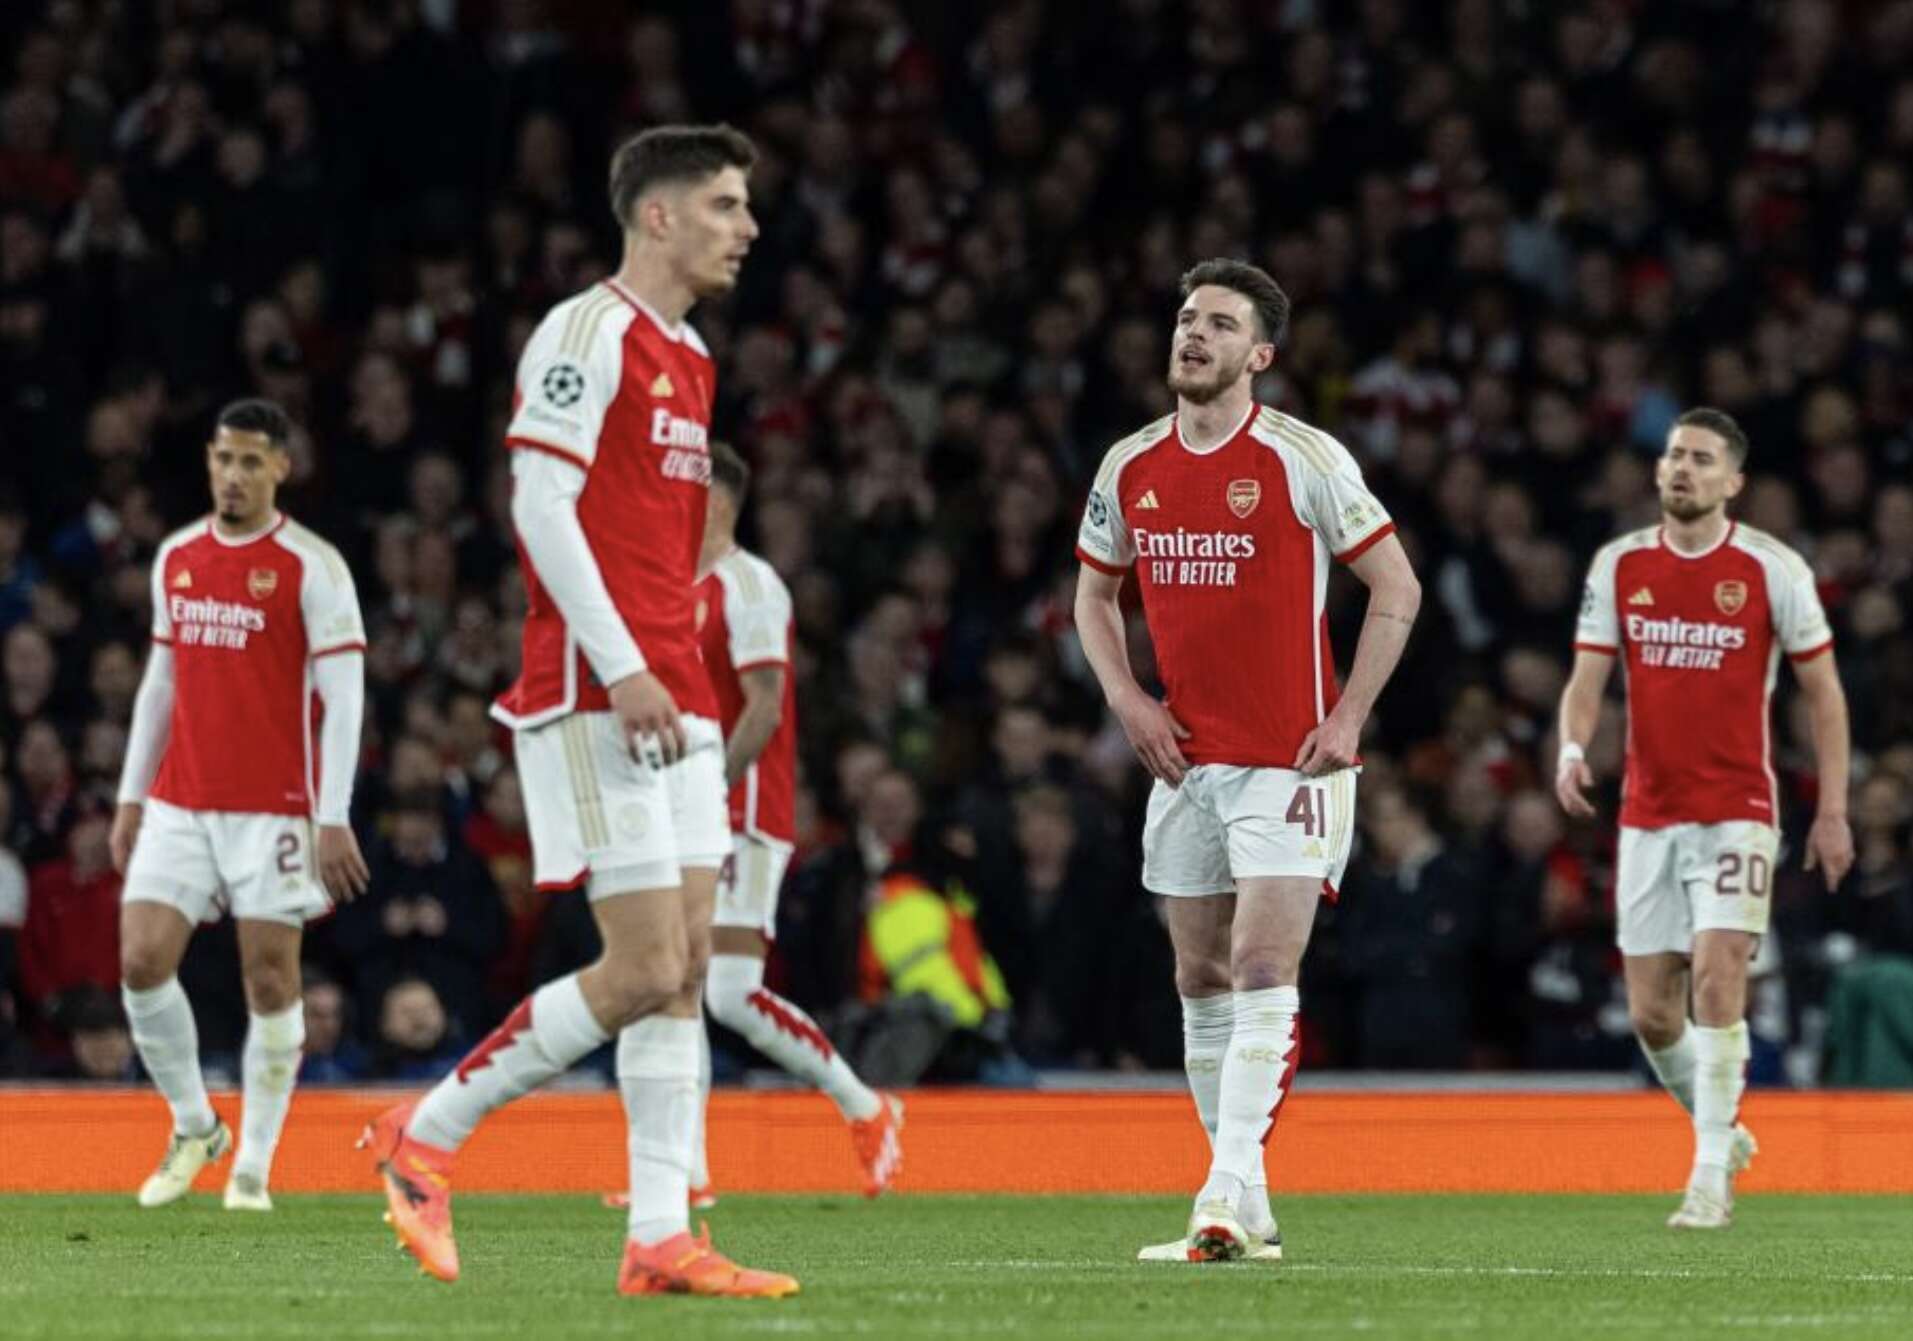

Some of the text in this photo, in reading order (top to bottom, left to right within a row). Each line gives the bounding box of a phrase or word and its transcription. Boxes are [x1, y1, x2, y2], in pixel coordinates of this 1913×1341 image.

[1133, 526, 1256, 558] Emirates
[1152, 561, 1237, 587] FLY BETTER
[171, 595, 265, 632] Emirates
[1626, 614, 1747, 650] Emirates
[1285, 784, 1326, 839] 41
[275, 832, 303, 874] 2
[1715, 852, 1769, 899] 20
